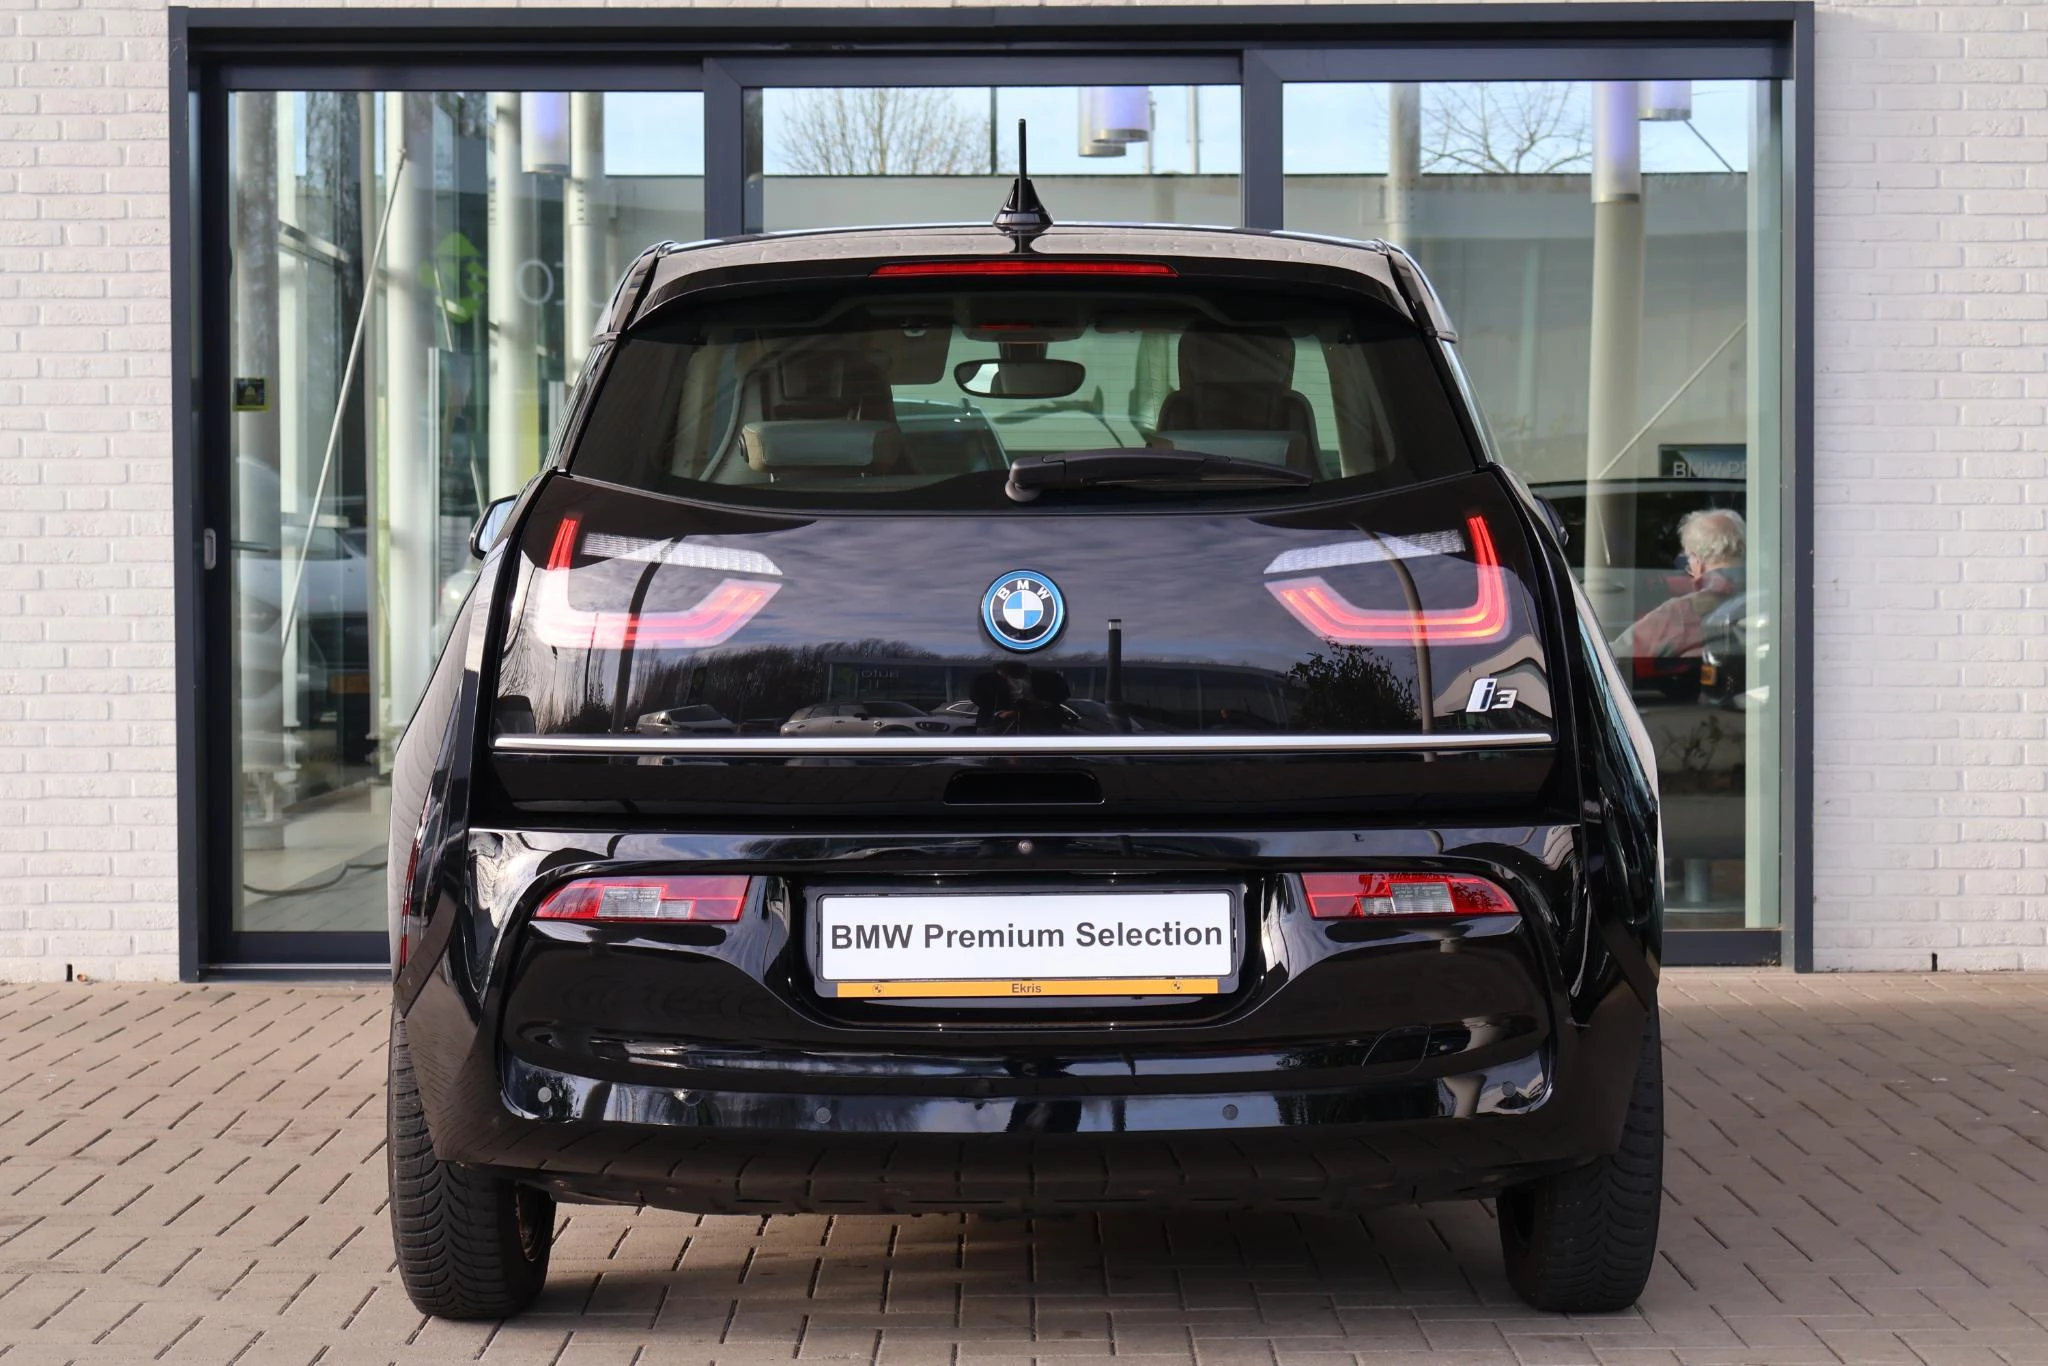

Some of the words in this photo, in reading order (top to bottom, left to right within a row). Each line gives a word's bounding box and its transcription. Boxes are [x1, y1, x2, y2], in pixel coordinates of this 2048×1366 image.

[997, 579, 1051, 601] BMW
[1466, 678, 1518, 713] i3
[831, 924, 914, 950] BMW
[924, 922, 1064, 949] Premium
[1076, 921, 1222, 948] Selection
[1011, 983, 1042, 994] Ekris
